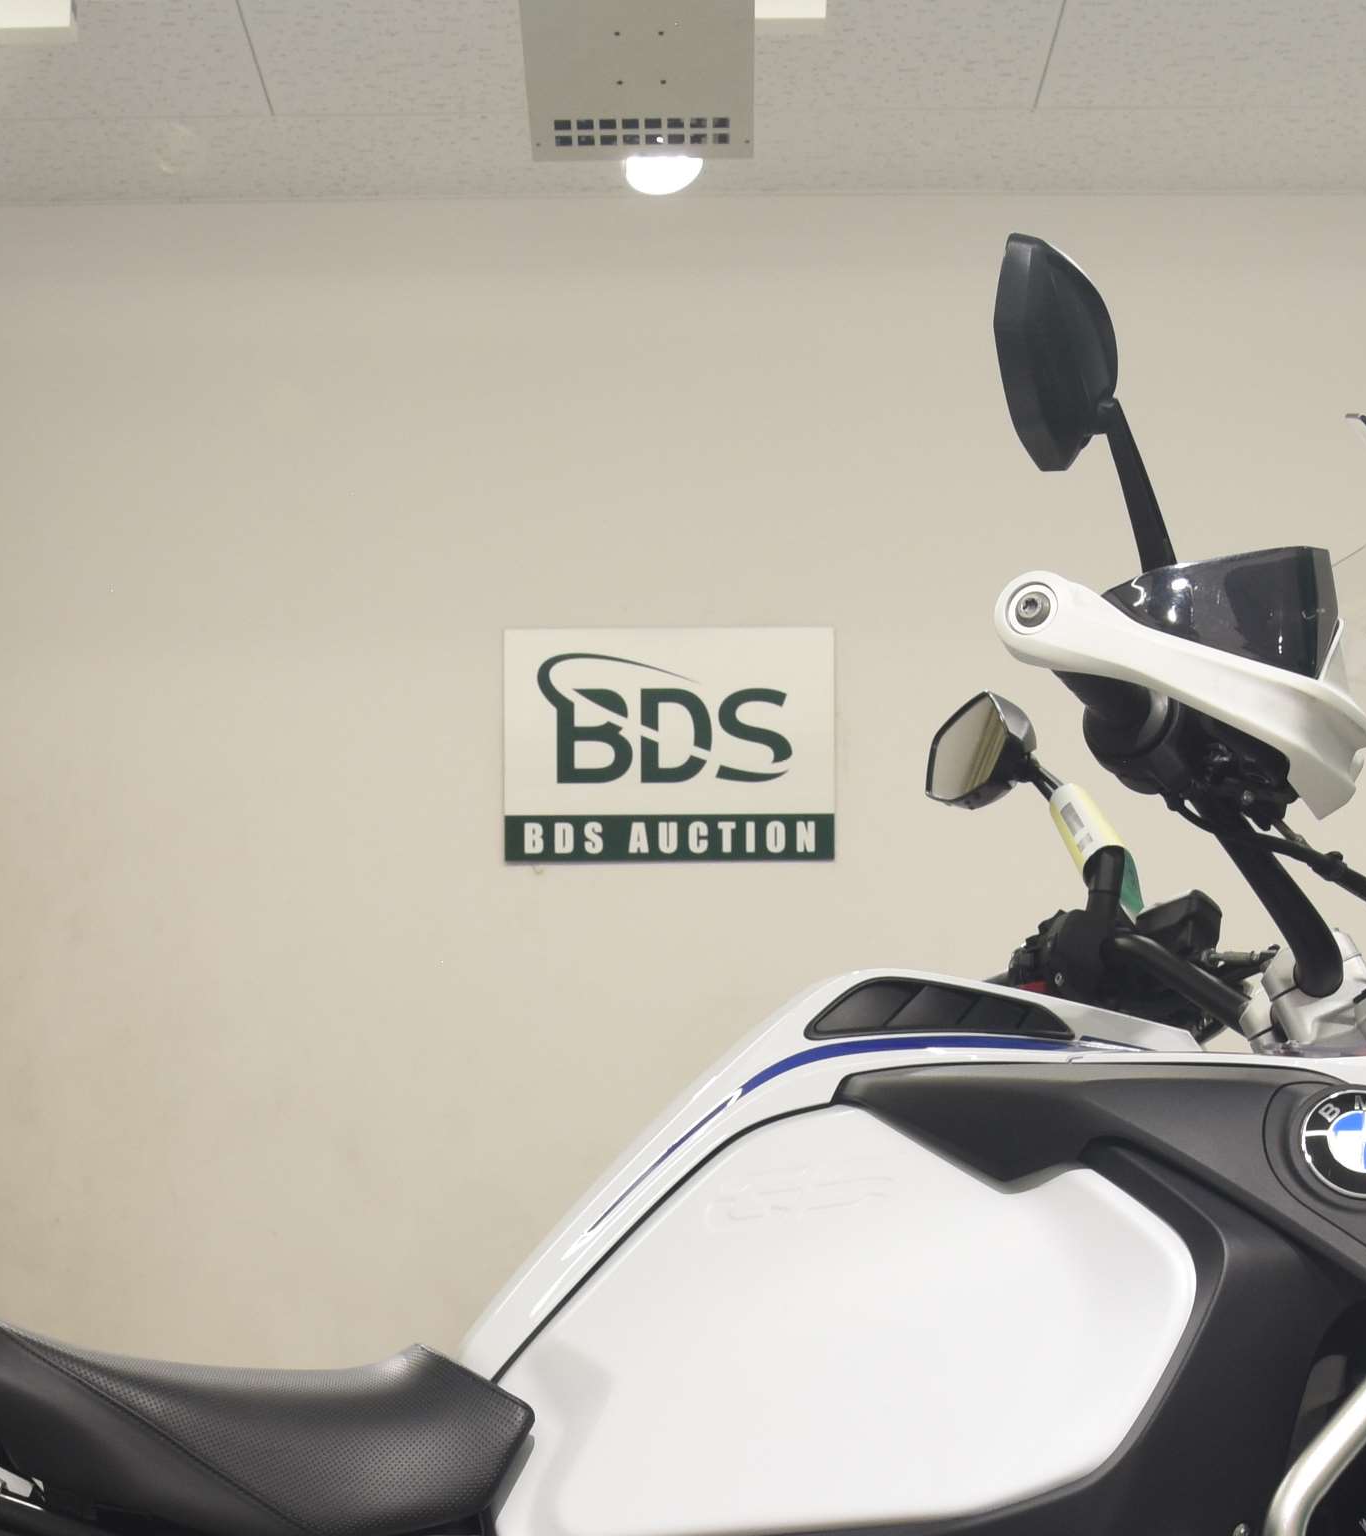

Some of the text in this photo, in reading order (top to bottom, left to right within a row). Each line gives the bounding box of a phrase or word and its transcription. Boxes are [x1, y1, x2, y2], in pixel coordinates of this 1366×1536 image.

[537, 652, 793, 784] BDS
[524, 821, 816, 855] BDS AUCTION
